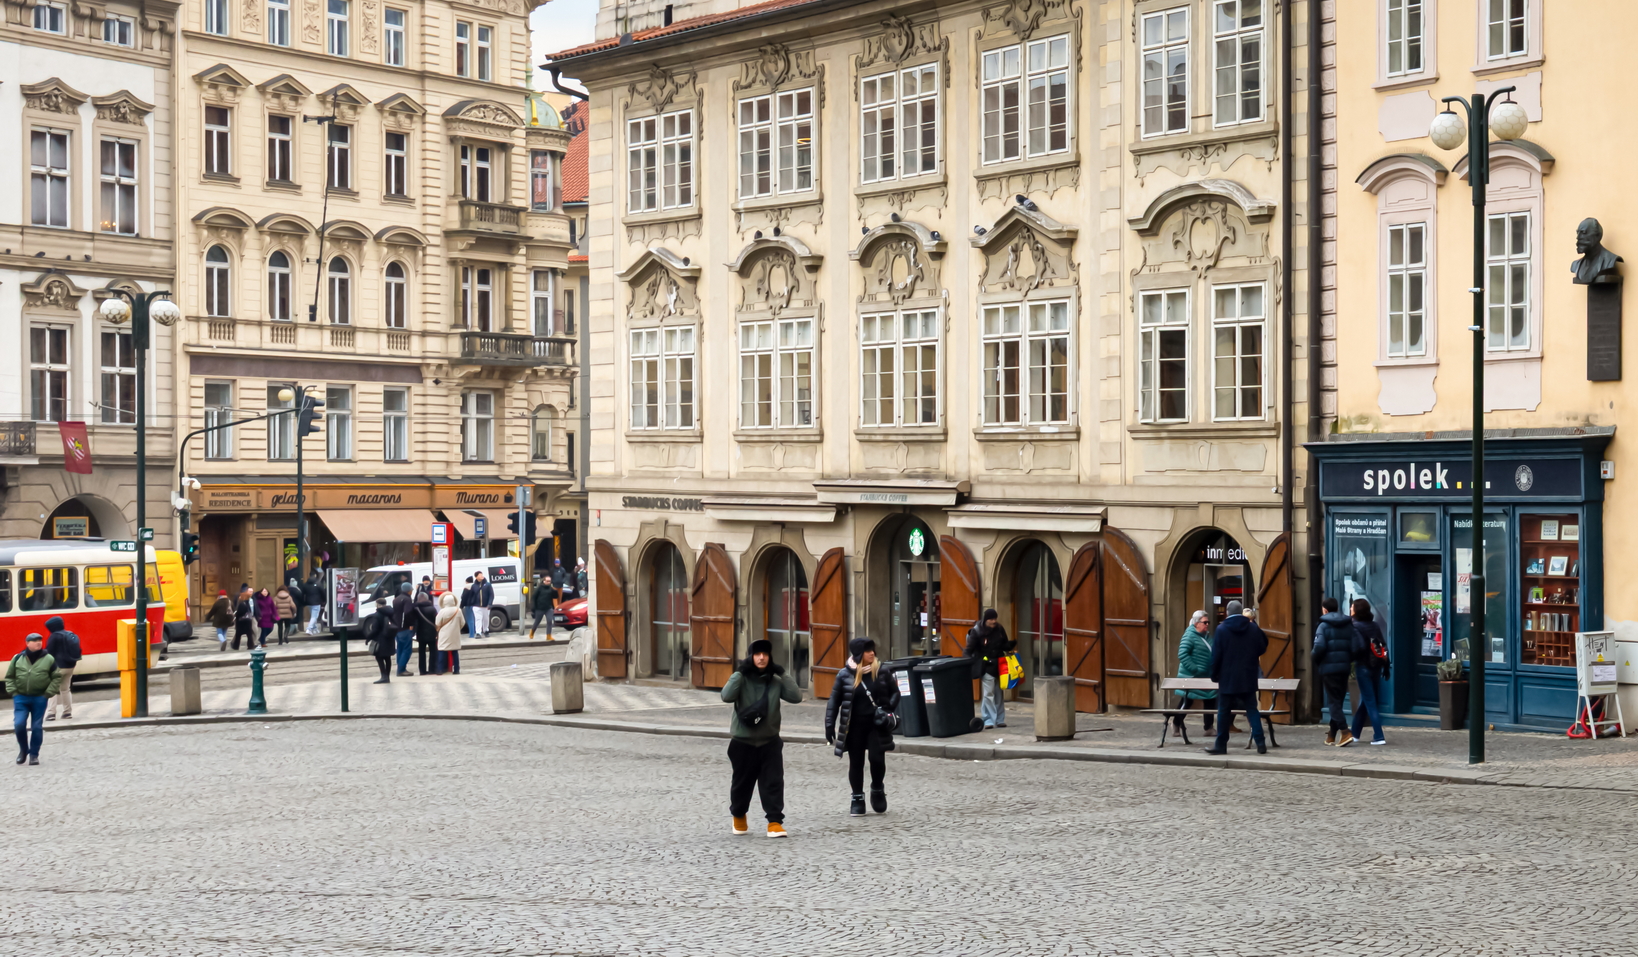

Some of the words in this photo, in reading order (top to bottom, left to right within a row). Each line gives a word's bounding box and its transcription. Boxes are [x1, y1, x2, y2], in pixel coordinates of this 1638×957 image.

[347, 493, 402, 505] macarons
[455, 491, 499, 504] Murano
[860, 494, 888, 502] STARBUCKS
[888, 494, 908, 502] COFFEE
[209, 499, 252, 507] RESIDENCE
[622, 496, 671, 510] STARBUCKS
[1347, 527, 1362, 535] Strany
[118, 542, 127, 550] WC
[491, 574, 515, 582] LOOMIS
